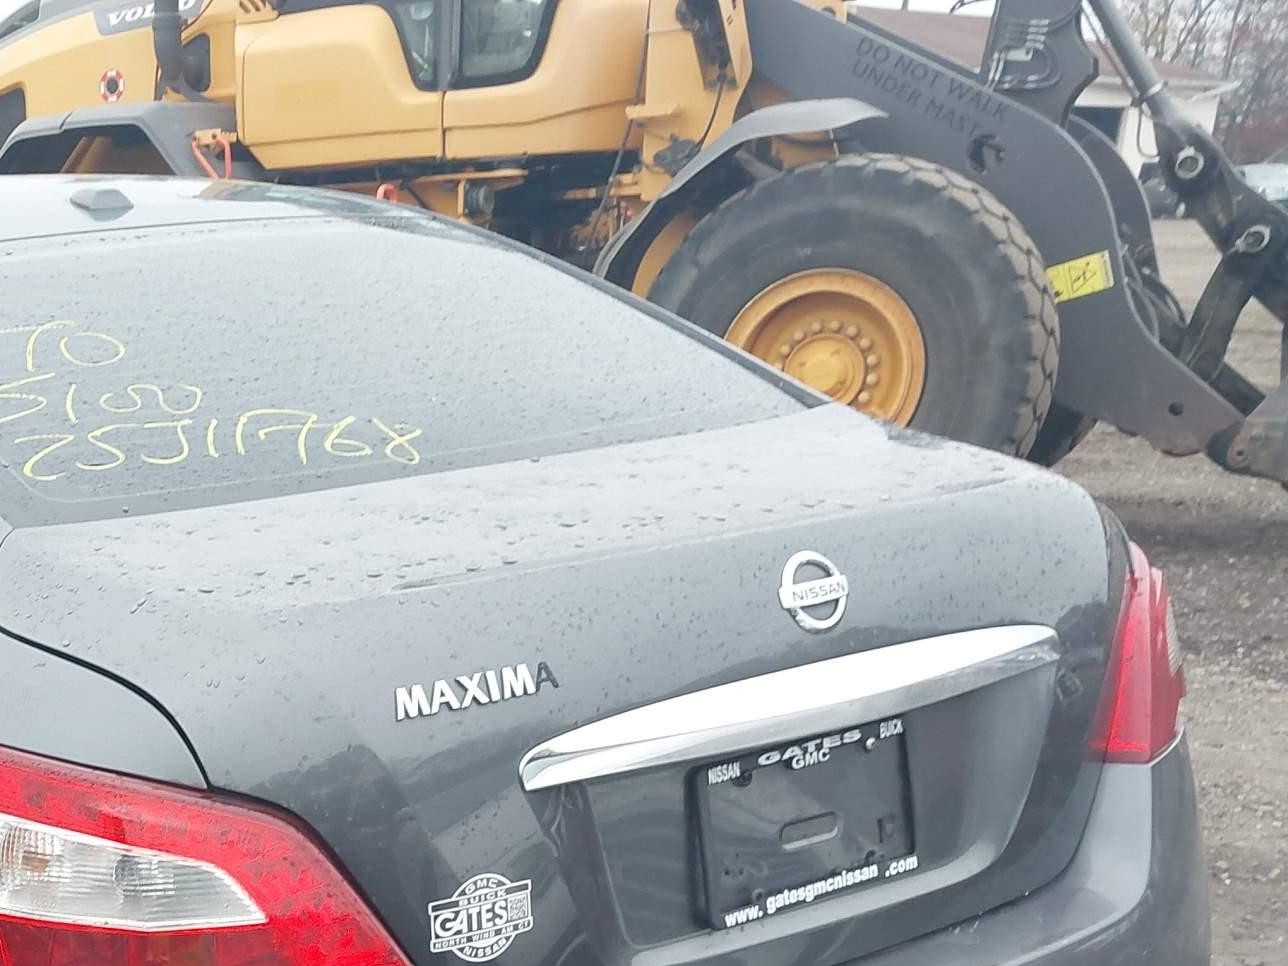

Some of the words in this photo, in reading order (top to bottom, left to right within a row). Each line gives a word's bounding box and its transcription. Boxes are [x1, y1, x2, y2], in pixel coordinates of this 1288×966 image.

[856, 36, 890, 63] DO
[894, 54, 942, 88] NOT
[947, 77, 1010, 122] WALK
[852, 57, 923, 107] UNDER
[924, 100, 980, 136] MAST
[792, 580, 846, 602] NISSAN
[395, 660, 561, 722] MAXIMA
[707, 761, 742, 786] NISSAN
[757, 728, 863, 767] GATES
[878, 718, 904, 740] BUICK
[791, 749, 831, 770] GMC
[457, 889, 508, 907] BUICK
[465, 878, 499, 895] GMC
[434, 900, 508, 938] GATES
[724, 904, 764, 928] www.
[462, 936, 508, 958] NISSAN
